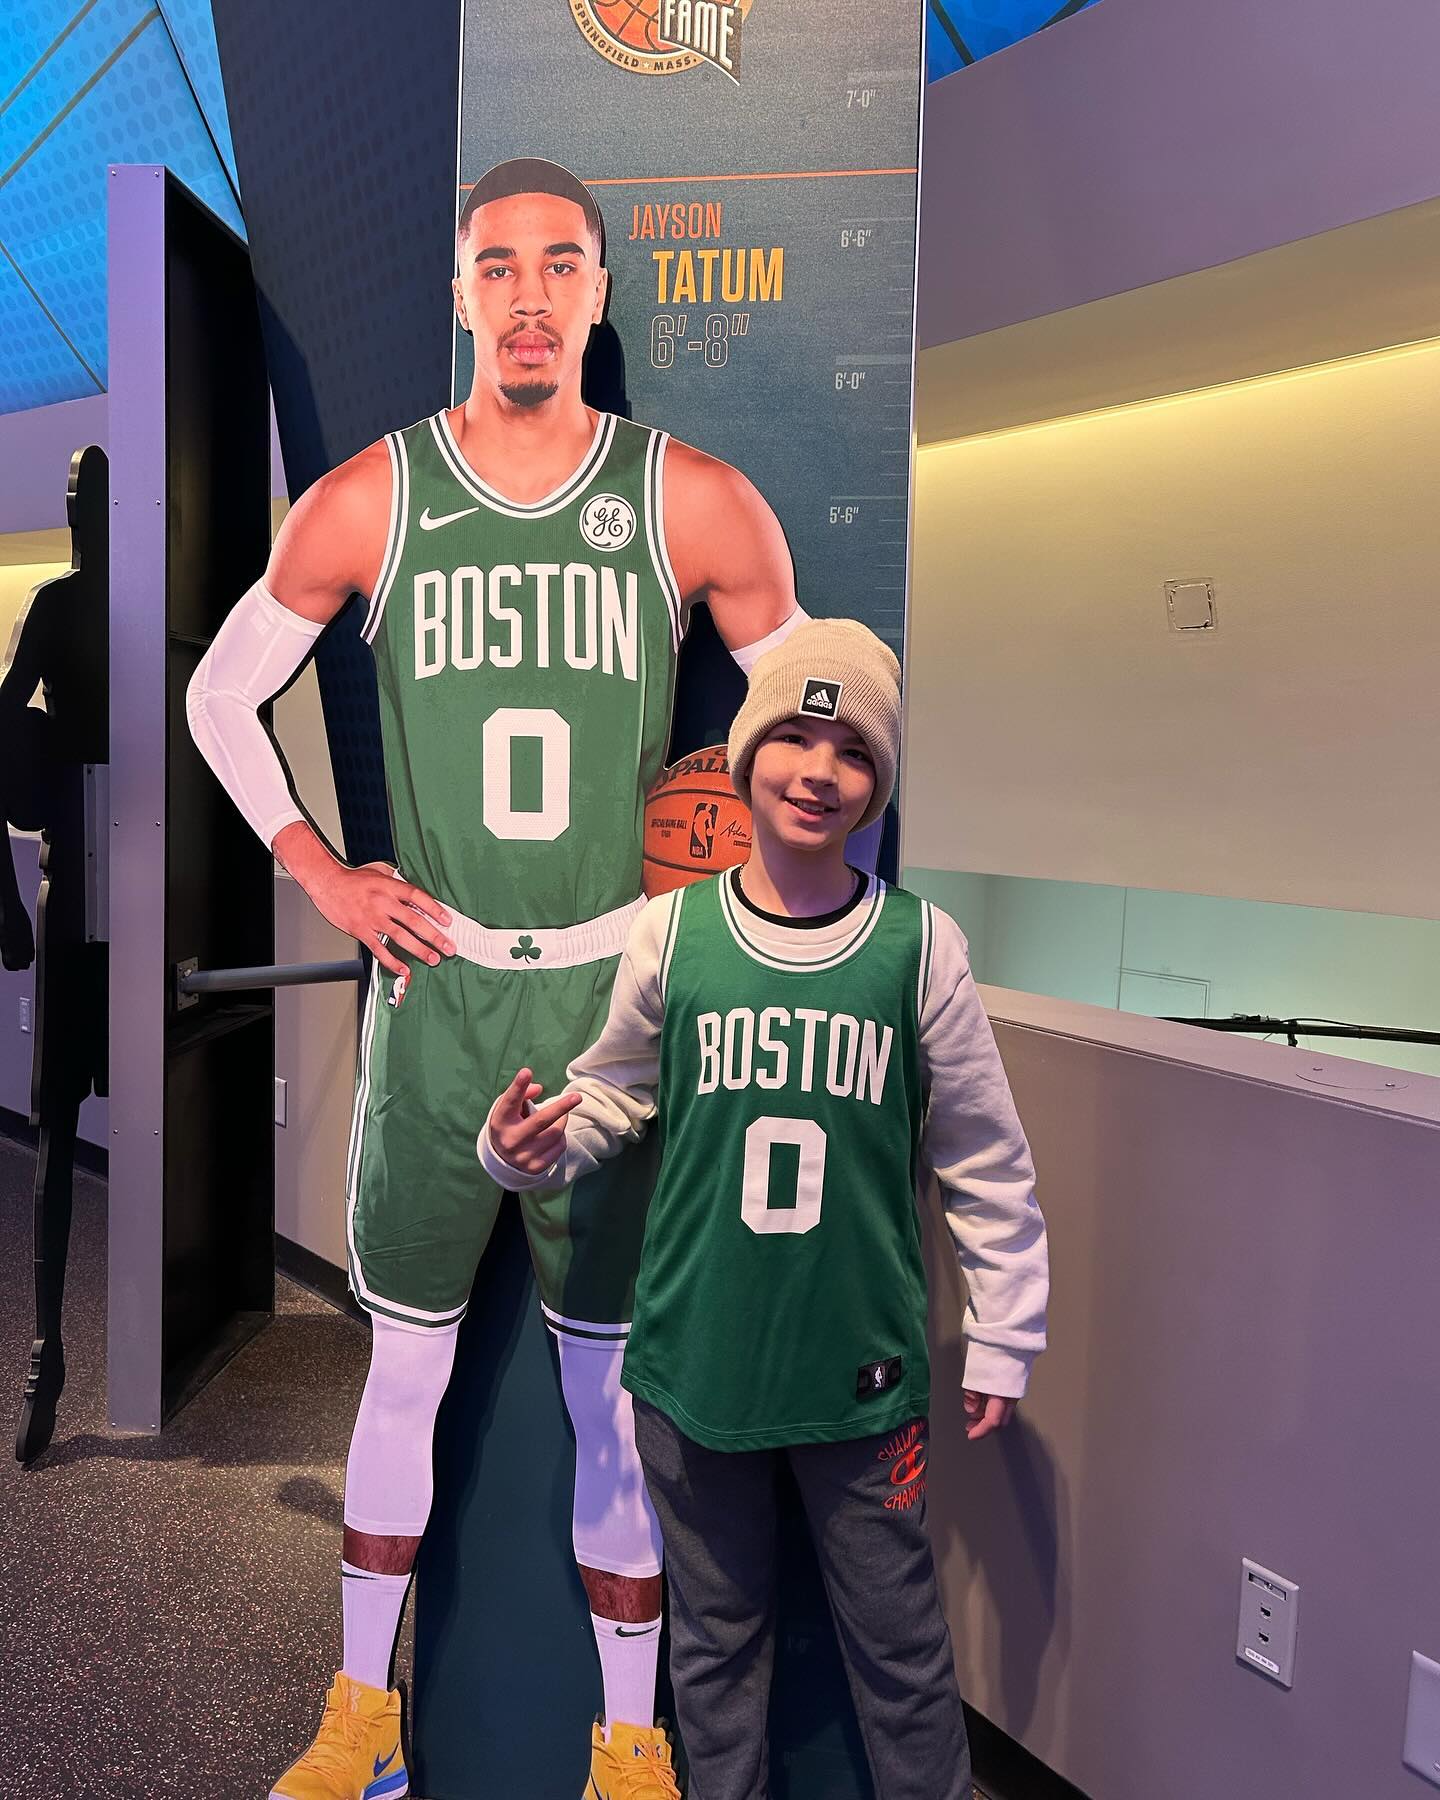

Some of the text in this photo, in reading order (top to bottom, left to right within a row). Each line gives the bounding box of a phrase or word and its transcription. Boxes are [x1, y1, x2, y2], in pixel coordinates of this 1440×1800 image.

[574, 2, 697, 71] SPRINGFIELD MASS.
[664, 0, 735, 70] FAME
[846, 88, 877, 108] 7'-0"
[628, 202, 722, 240] JAYSON
[840, 229, 872, 248] 6'-6"
[652, 247, 785, 304] TATUM
[650, 313, 750, 369] 6'-8"
[835, 371, 866, 390] 6'-0"
[829, 506, 859, 524] 5'-6"
[413, 562, 638, 681] BOSTON
[806, 698, 833, 710] adidas
[482, 707, 571, 842] 0
[697, 1006, 894, 1106] BOSTON
[740, 1115, 827, 1235] 0
